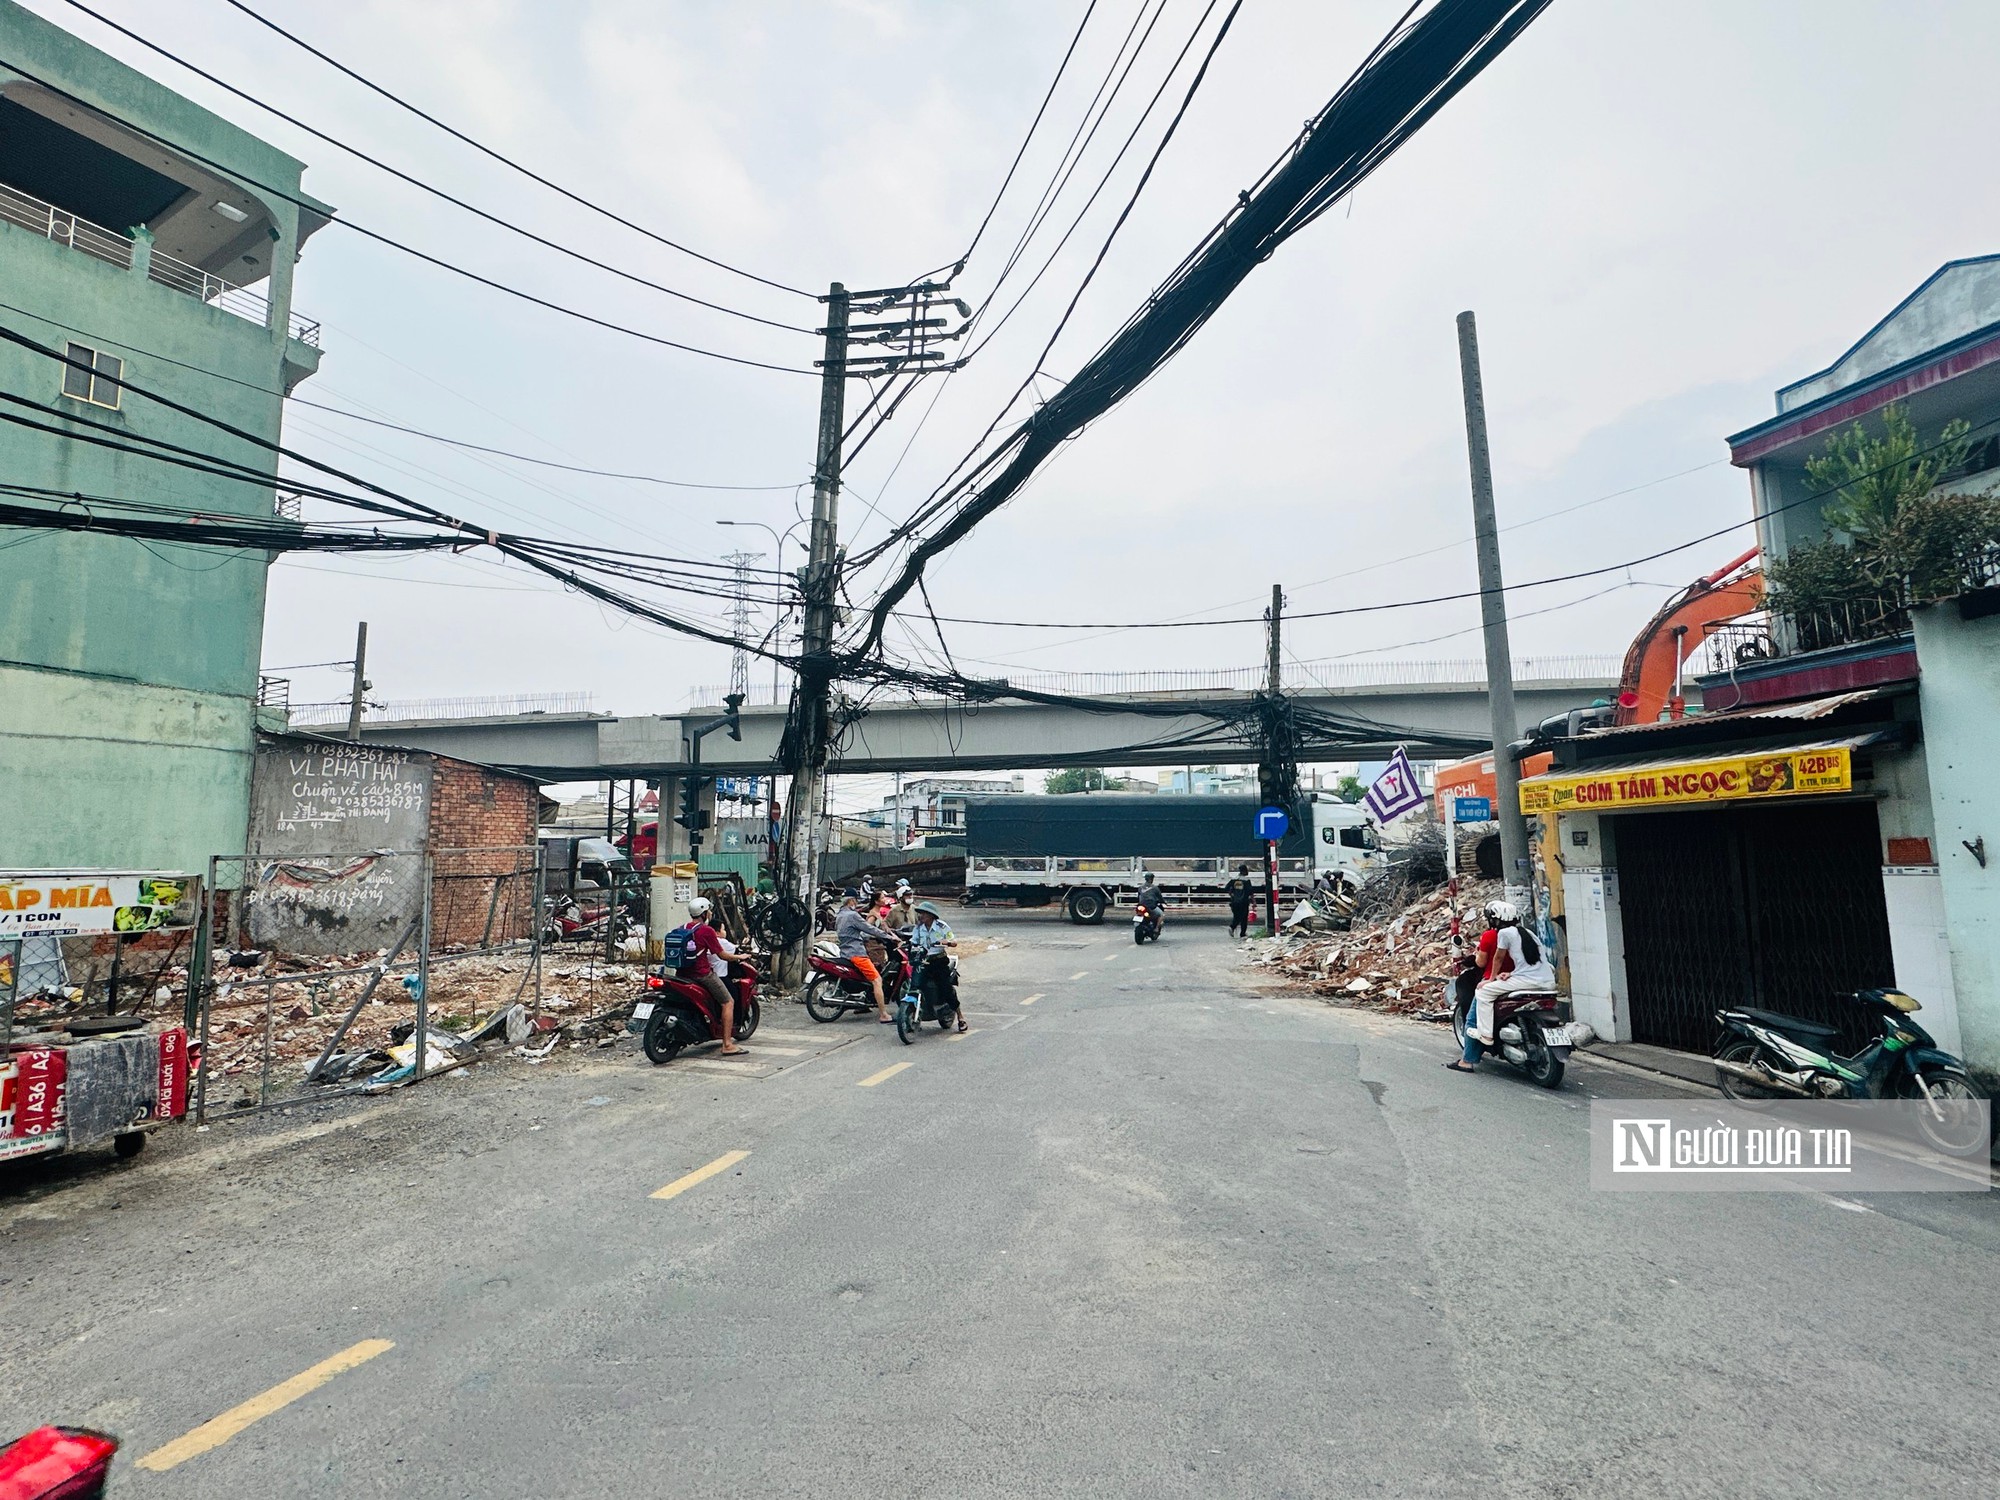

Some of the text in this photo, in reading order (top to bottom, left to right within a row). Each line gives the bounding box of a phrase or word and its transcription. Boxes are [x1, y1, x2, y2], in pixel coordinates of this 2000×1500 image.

[1799, 755, 1840, 775] 42B BIS
[1553, 769, 1739, 805] Quán CƠM TẤM NGỌC
